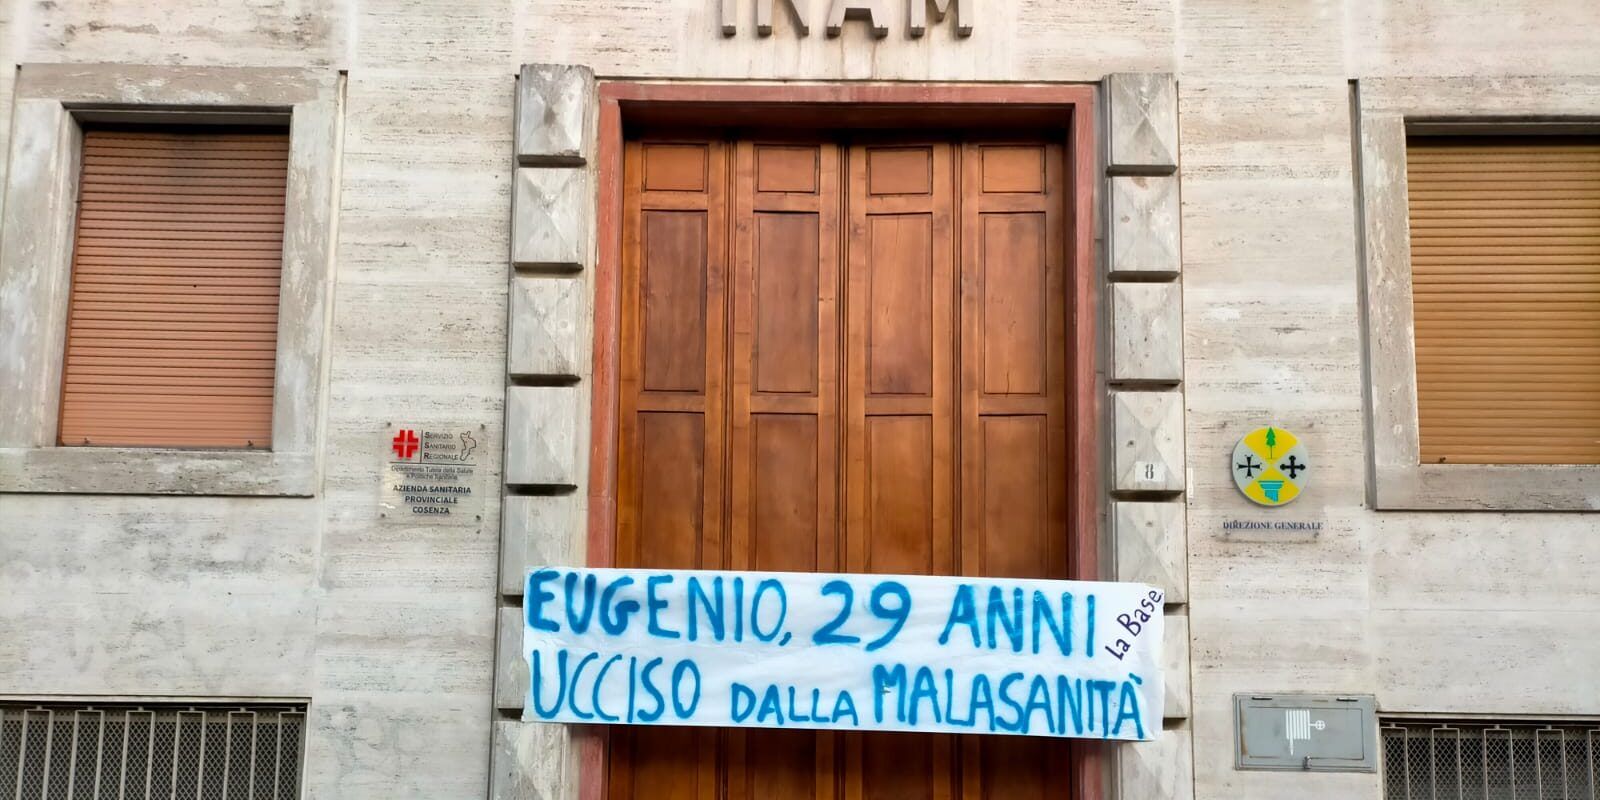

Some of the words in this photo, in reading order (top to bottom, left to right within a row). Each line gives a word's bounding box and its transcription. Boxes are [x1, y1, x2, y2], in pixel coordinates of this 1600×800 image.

[1145, 463, 1154, 480] 8
[393, 485, 427, 493] AZIENDA
[429, 485, 471, 494] SANITARIA
[405, 495, 458, 504] PROVINCIALE
[412, 506, 450, 515] COSENZA
[1223, 521, 1272, 530] DIREZIONE
[1274, 521, 1324, 531] GENERALE
[527, 569, 792, 646] EUGENIO,
[812, 580, 912, 652] 29
[938, 583, 1095, 657] ANNI
[1117, 590, 1162, 637] Base
[532, 649, 700, 723] UCCISO
[731, 682, 859, 726] DALLA
[872, 663, 1144, 739] MALASANITÀ
